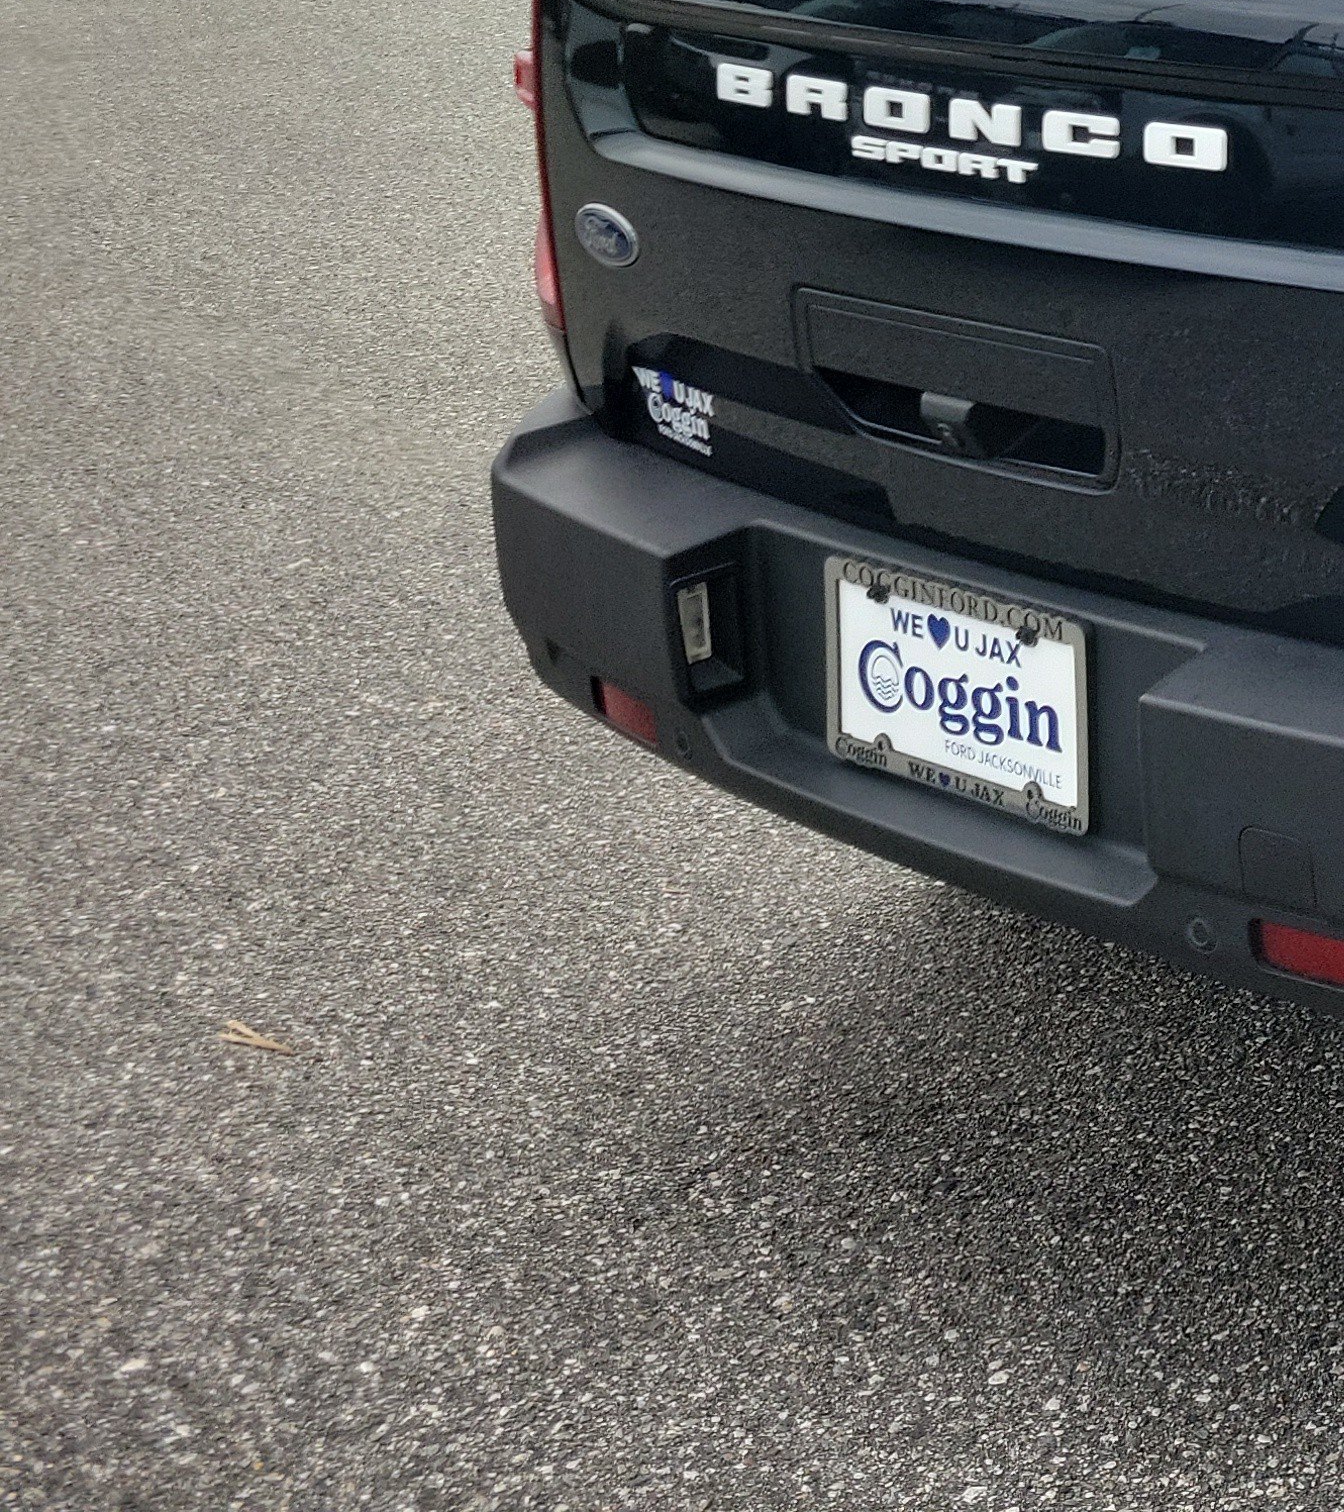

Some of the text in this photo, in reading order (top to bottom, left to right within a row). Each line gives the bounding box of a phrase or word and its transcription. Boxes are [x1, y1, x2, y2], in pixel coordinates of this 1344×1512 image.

[715, 62, 1229, 172] BRONCO
[851, 135, 1040, 184] SPORT
[632, 366, 661, 393] WE
[647, 392, 711, 441] Coggin
[842, 561, 1064, 640] COGGINFORD.COM
[890, 608, 1022, 668] WE U JAX
[858, 640, 1063, 753] Coggin
[835, 736, 888, 768] Coggin
[944, 739, 1062, 790] FORD JACKSONVILLE
[908, 761, 1005, 808] WE U JAX
[1025, 795, 1083, 832] Coggin
